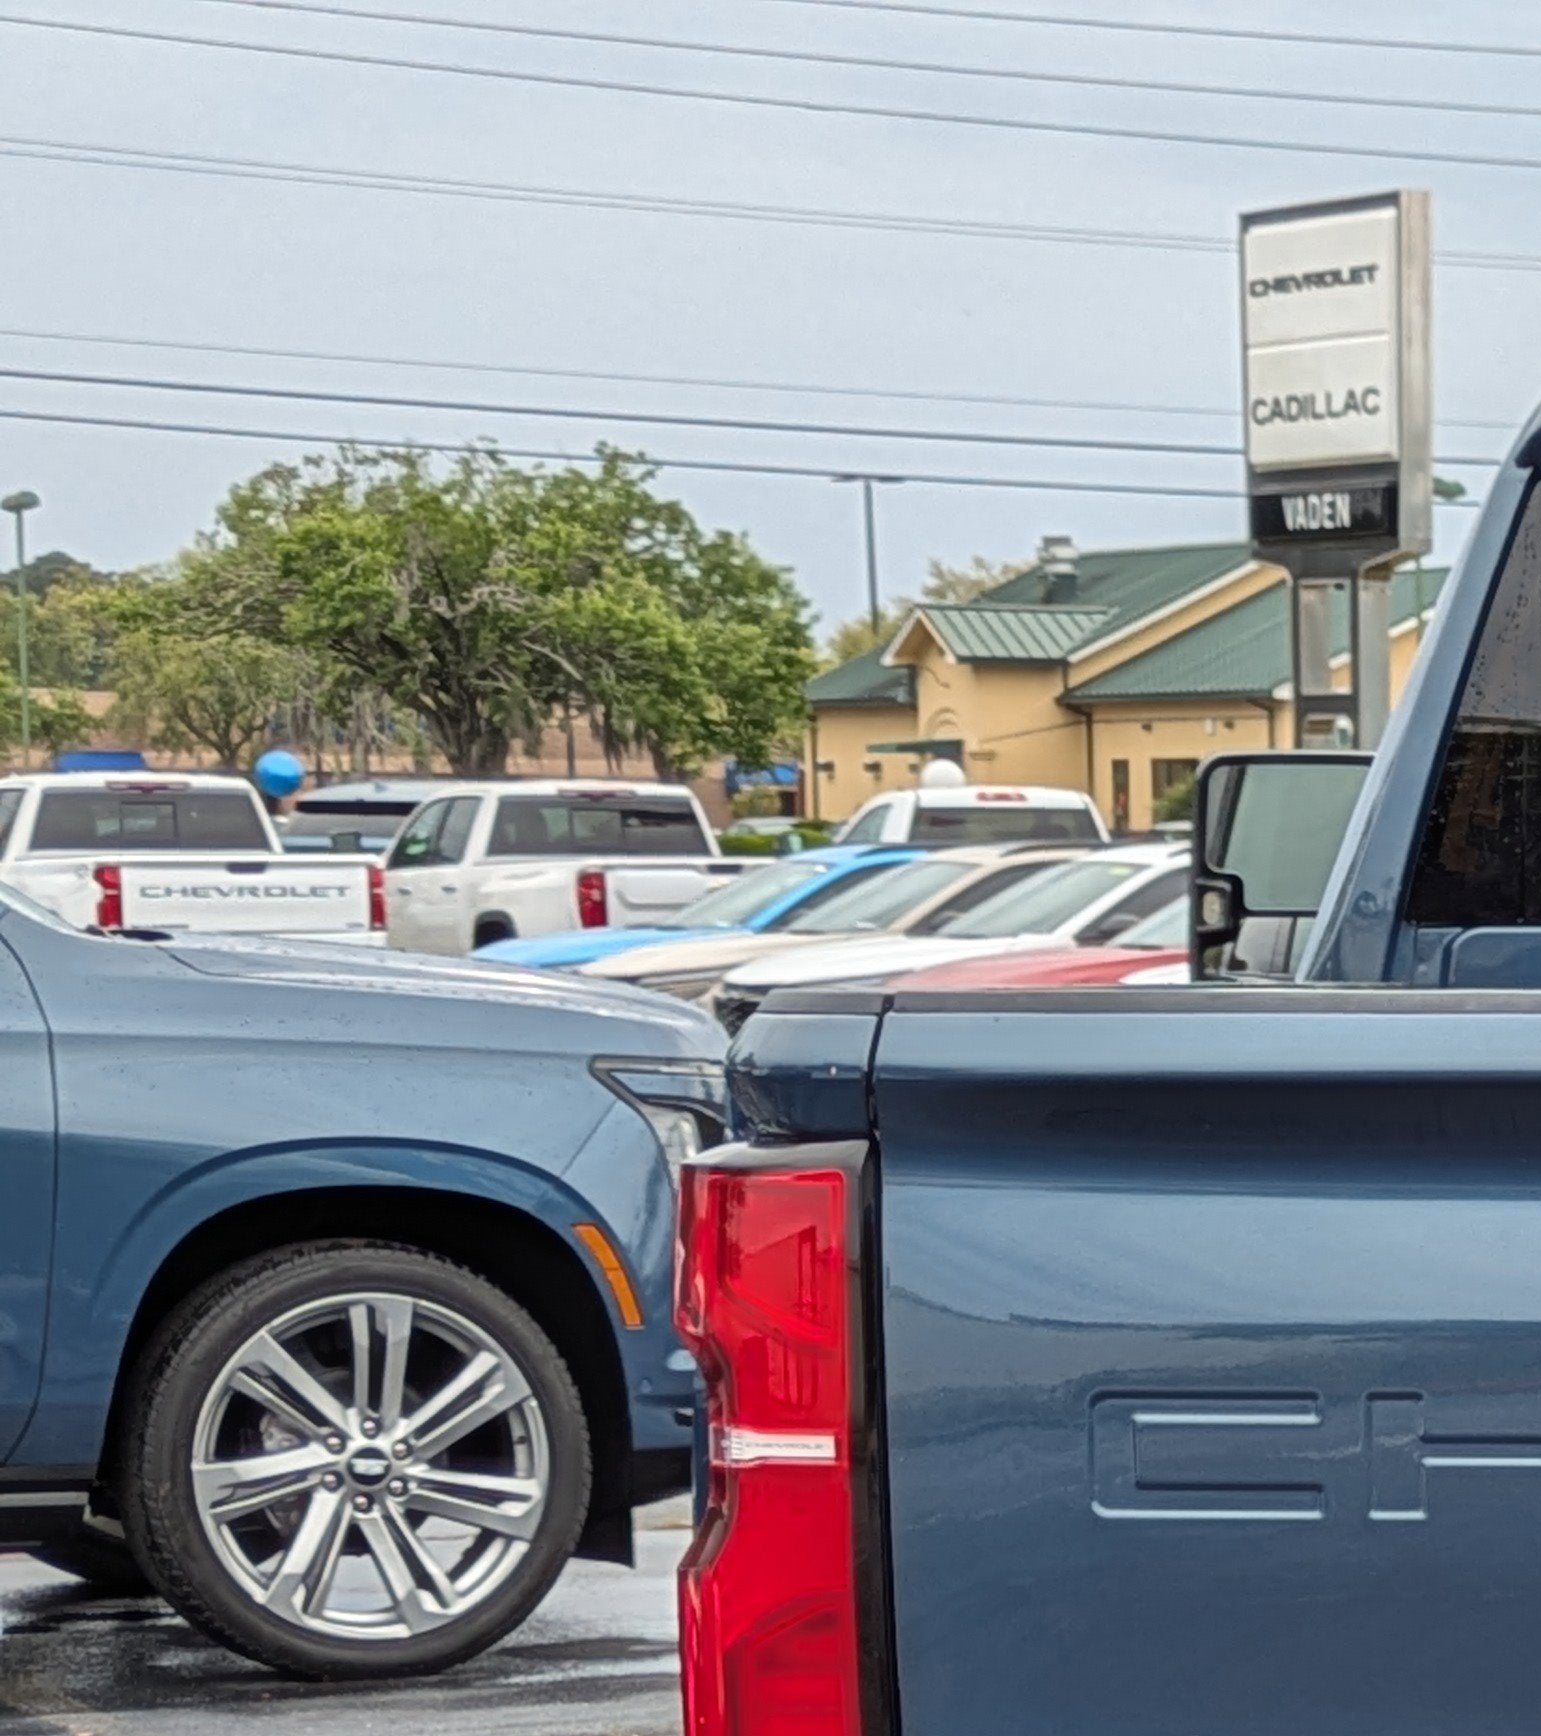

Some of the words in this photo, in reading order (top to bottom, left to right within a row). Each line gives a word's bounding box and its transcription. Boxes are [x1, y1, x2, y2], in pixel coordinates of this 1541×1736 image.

[1249, 263, 1380, 298] CHEVROLET
[1251, 387, 1381, 425] CADILLAC
[1281, 492, 1353, 532] VADEN
[139, 886, 351, 899] CHEVROLET
